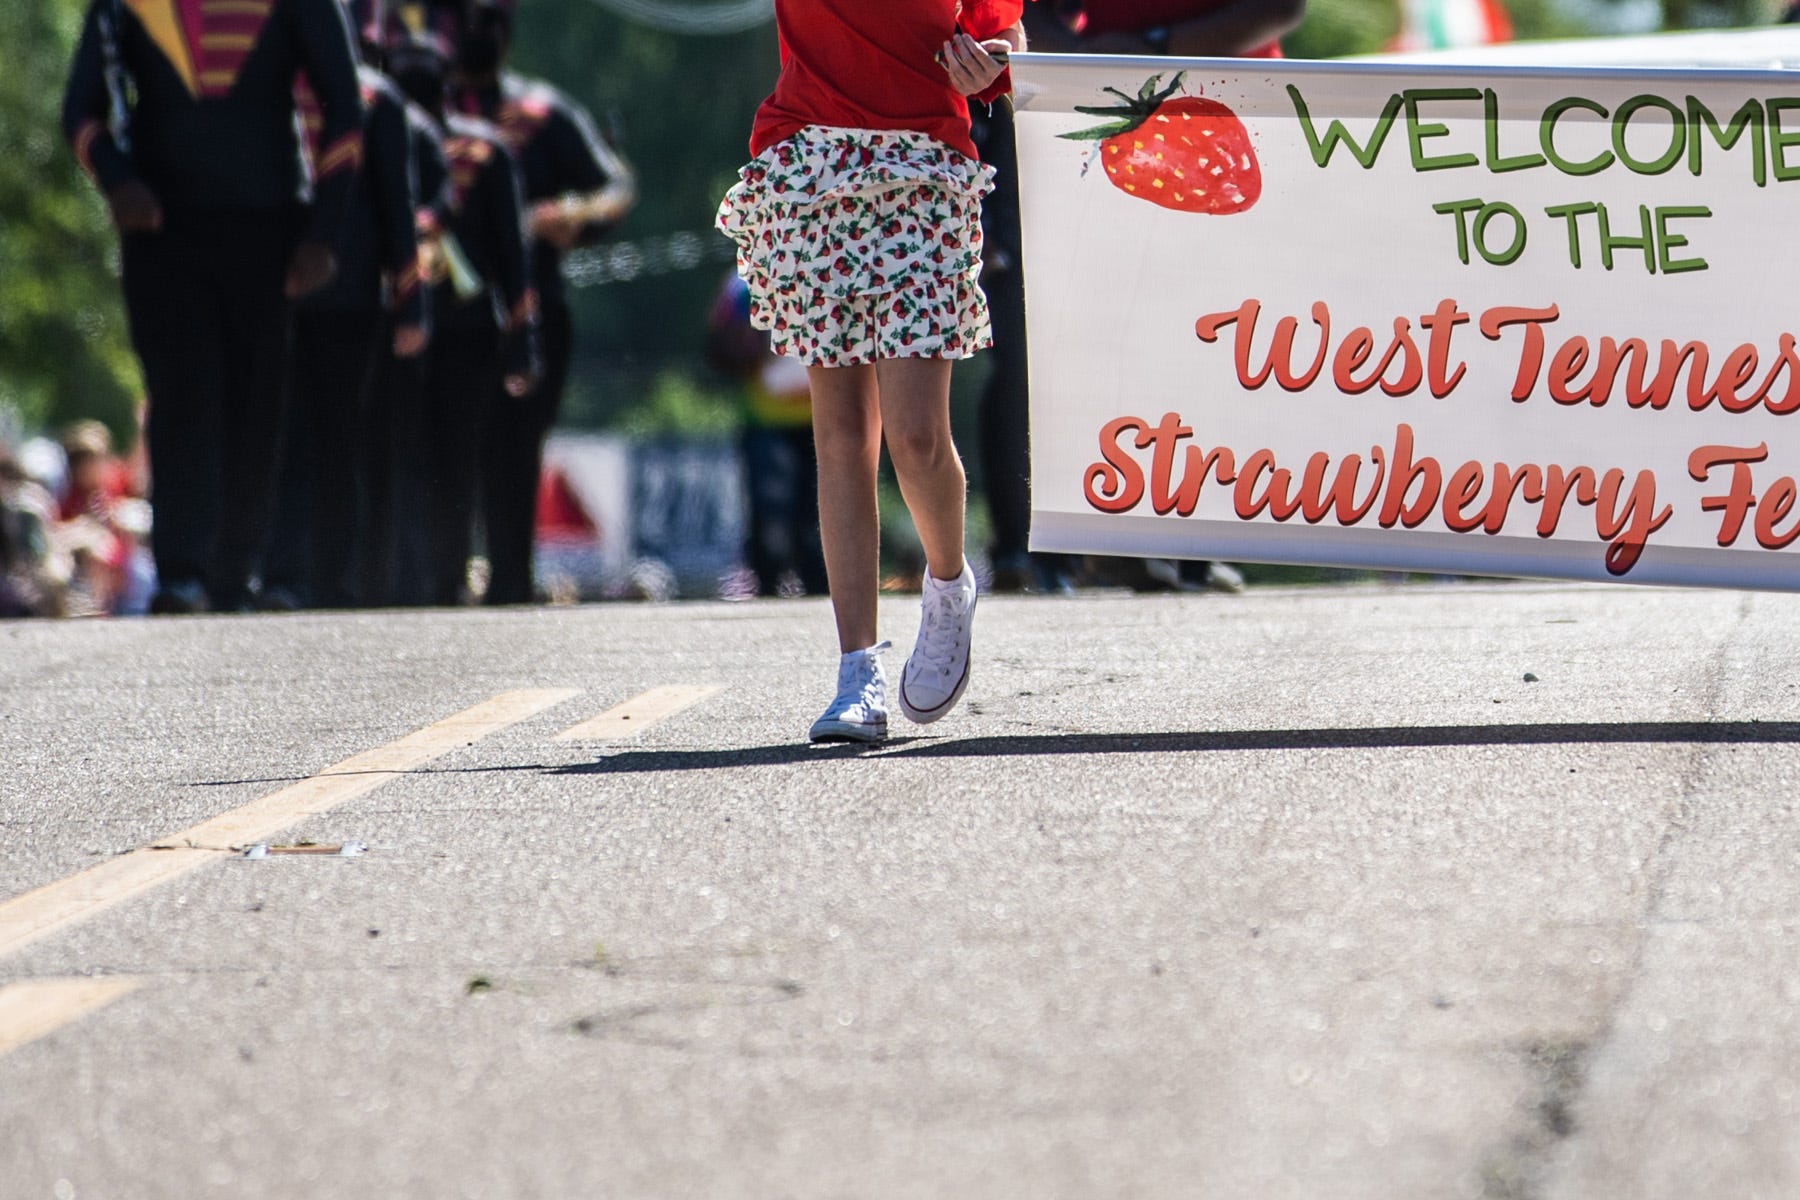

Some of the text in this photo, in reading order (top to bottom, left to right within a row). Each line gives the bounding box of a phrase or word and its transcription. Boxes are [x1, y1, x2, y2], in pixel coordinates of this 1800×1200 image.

[1432, 198, 1713, 274] TO THE
[1197, 298, 1470, 398] West
[1083, 411, 1673, 576] Strawberry
